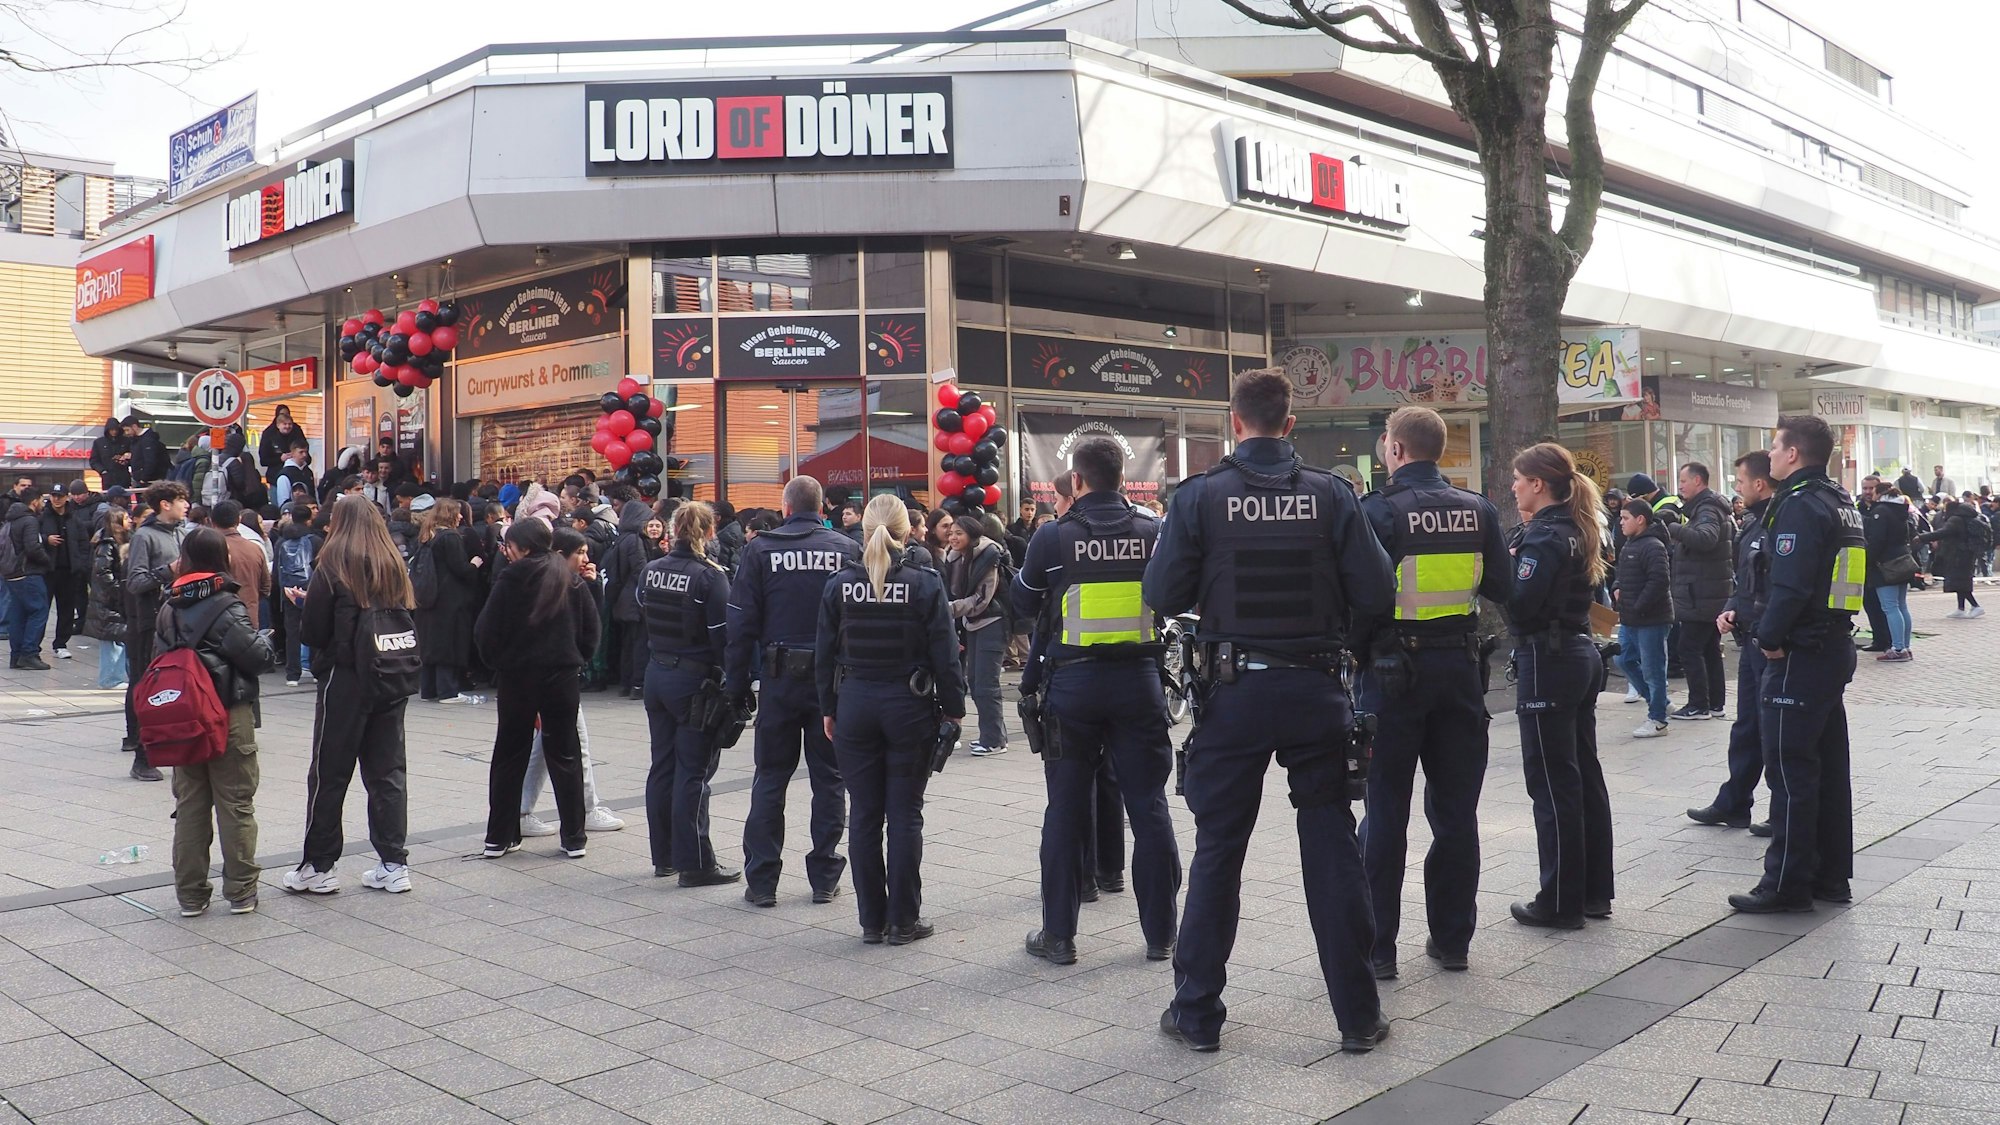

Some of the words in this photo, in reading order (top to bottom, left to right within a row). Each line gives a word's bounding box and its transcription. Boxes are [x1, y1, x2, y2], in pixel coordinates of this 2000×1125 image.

[589, 97, 714, 162] LORD
[729, 106, 770, 149] OF
[785, 81, 948, 158] DÖNER
[187, 125, 213, 152] Schuh
[212, 120, 222, 145] &
[1245, 136, 1313, 204] LORD
[1317, 162, 1339, 200] OF
[1343, 154, 1410, 226] DÖNER
[222, 189, 261, 251] LORD
[283, 158, 343, 231] DÖNER
[77, 268, 124, 310] DERPART
[499, 299, 518, 328] Unser
[517, 286, 555, 306] Geheimnis
[508, 313, 560, 335] BERLINER
[520, 331, 547, 344] Saucen
[739, 330, 768, 351] Unser
[766, 324, 819, 338] Geheimnis
[818, 330, 841, 350] liegt
[754, 346, 826, 357] BERLINER
[771, 356, 809, 366] Saucen
[1090, 353, 1111, 374] Unser
[1110, 348, 1148, 365] Geheimnis
[1352, 344, 1487, 391] BUBBL
[1559, 339, 1616, 389] EA
[467, 368, 535, 397] Currywurst
[538, 366, 548, 386] &
[552, 360, 609, 384] Pommes
[1101, 371, 1152, 385] BERLINER
[1113, 382, 1140, 393] Saucen
[1691, 391, 1725, 407] Haarstudio
[1725, 394, 1751, 413] Freestyle
[1817, 395, 1865, 416] SCHMIDT
[1056, 421, 1135, 461] ERÖFFNUNGSANGEBOT
[1227, 495, 1317, 521] POLIZEI
[1408, 510, 1479, 534] POLIZEI
[1074, 539, 1146, 561] POLIZEI
[770, 551, 842, 573] POLIZEI
[645, 570, 691, 593] POLIZEI
[374, 630, 417, 651] VANS
[1772, 697, 1794, 705] POLIZEI
